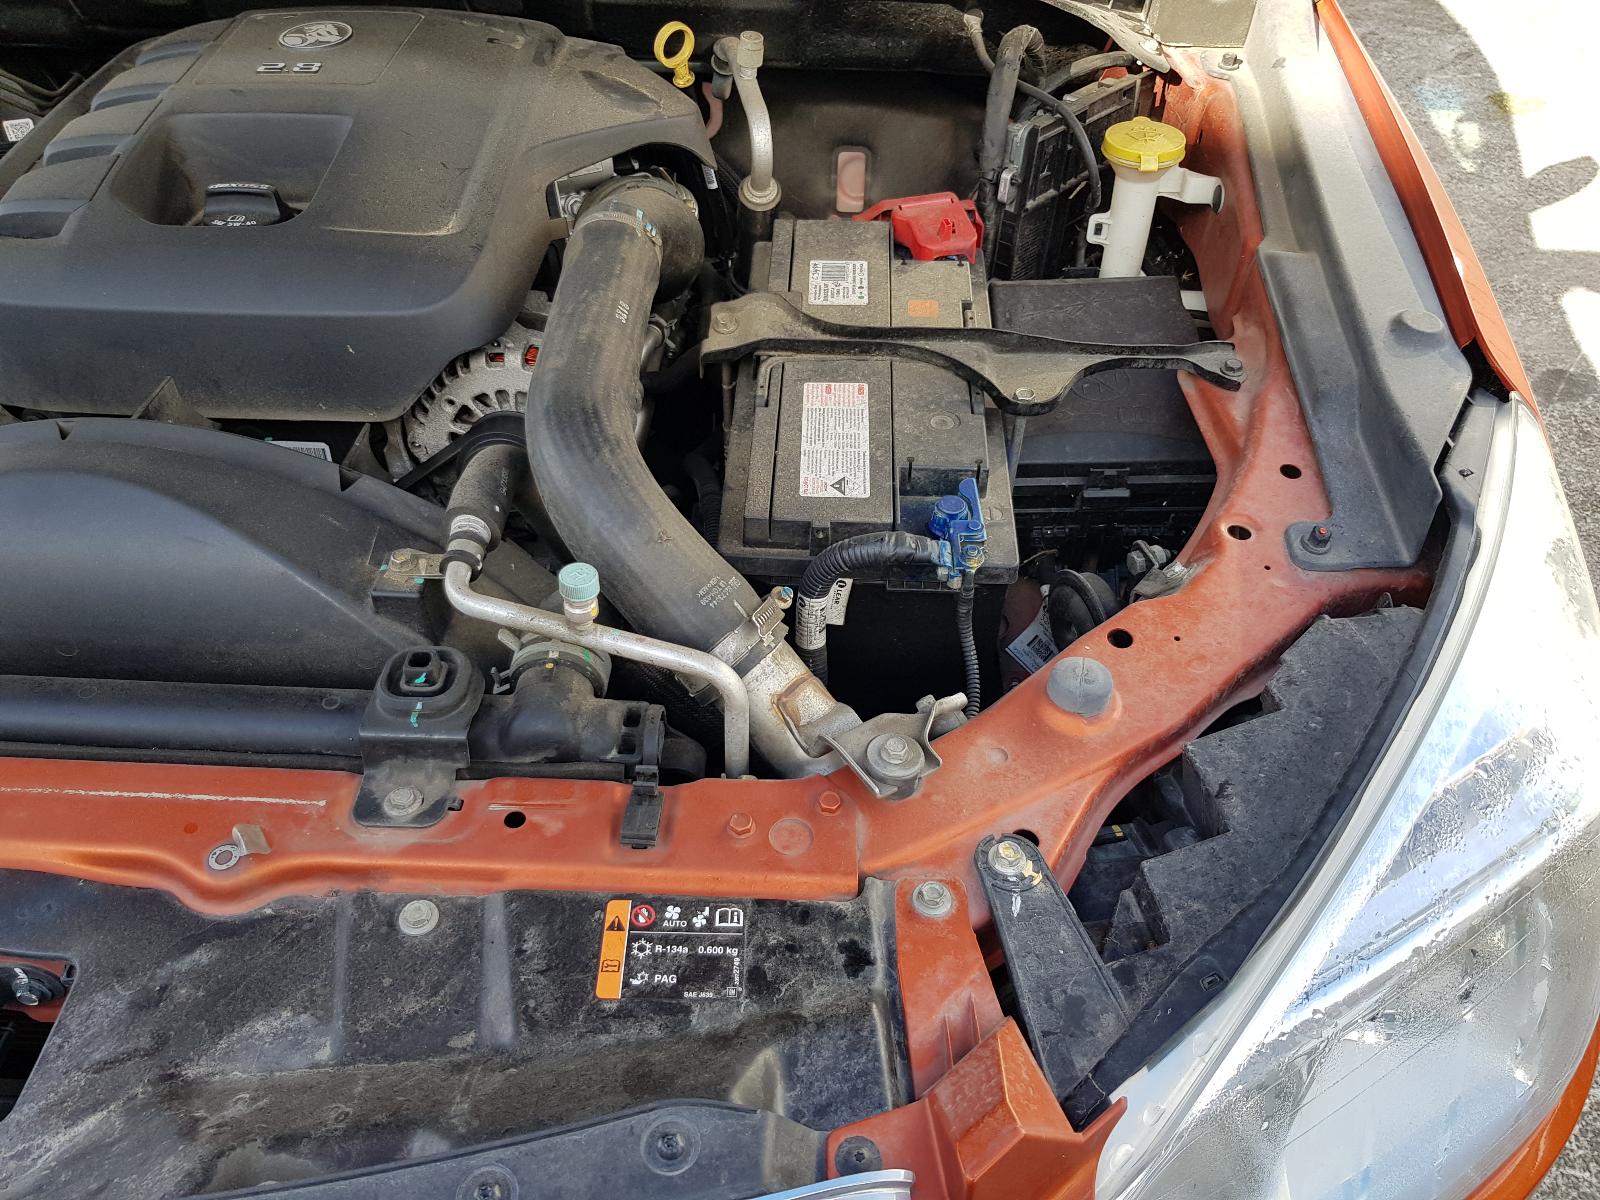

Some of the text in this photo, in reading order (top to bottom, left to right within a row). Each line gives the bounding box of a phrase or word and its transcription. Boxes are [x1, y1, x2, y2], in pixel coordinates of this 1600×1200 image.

[256, 62, 322, 72] 2.8
[834, 589, 843, 605] LEAR
[662, 920, 688, 928] AUTO
[655, 945, 739, 956] R-134a 0.600 kg
[654, 974, 677, 984] PAG
